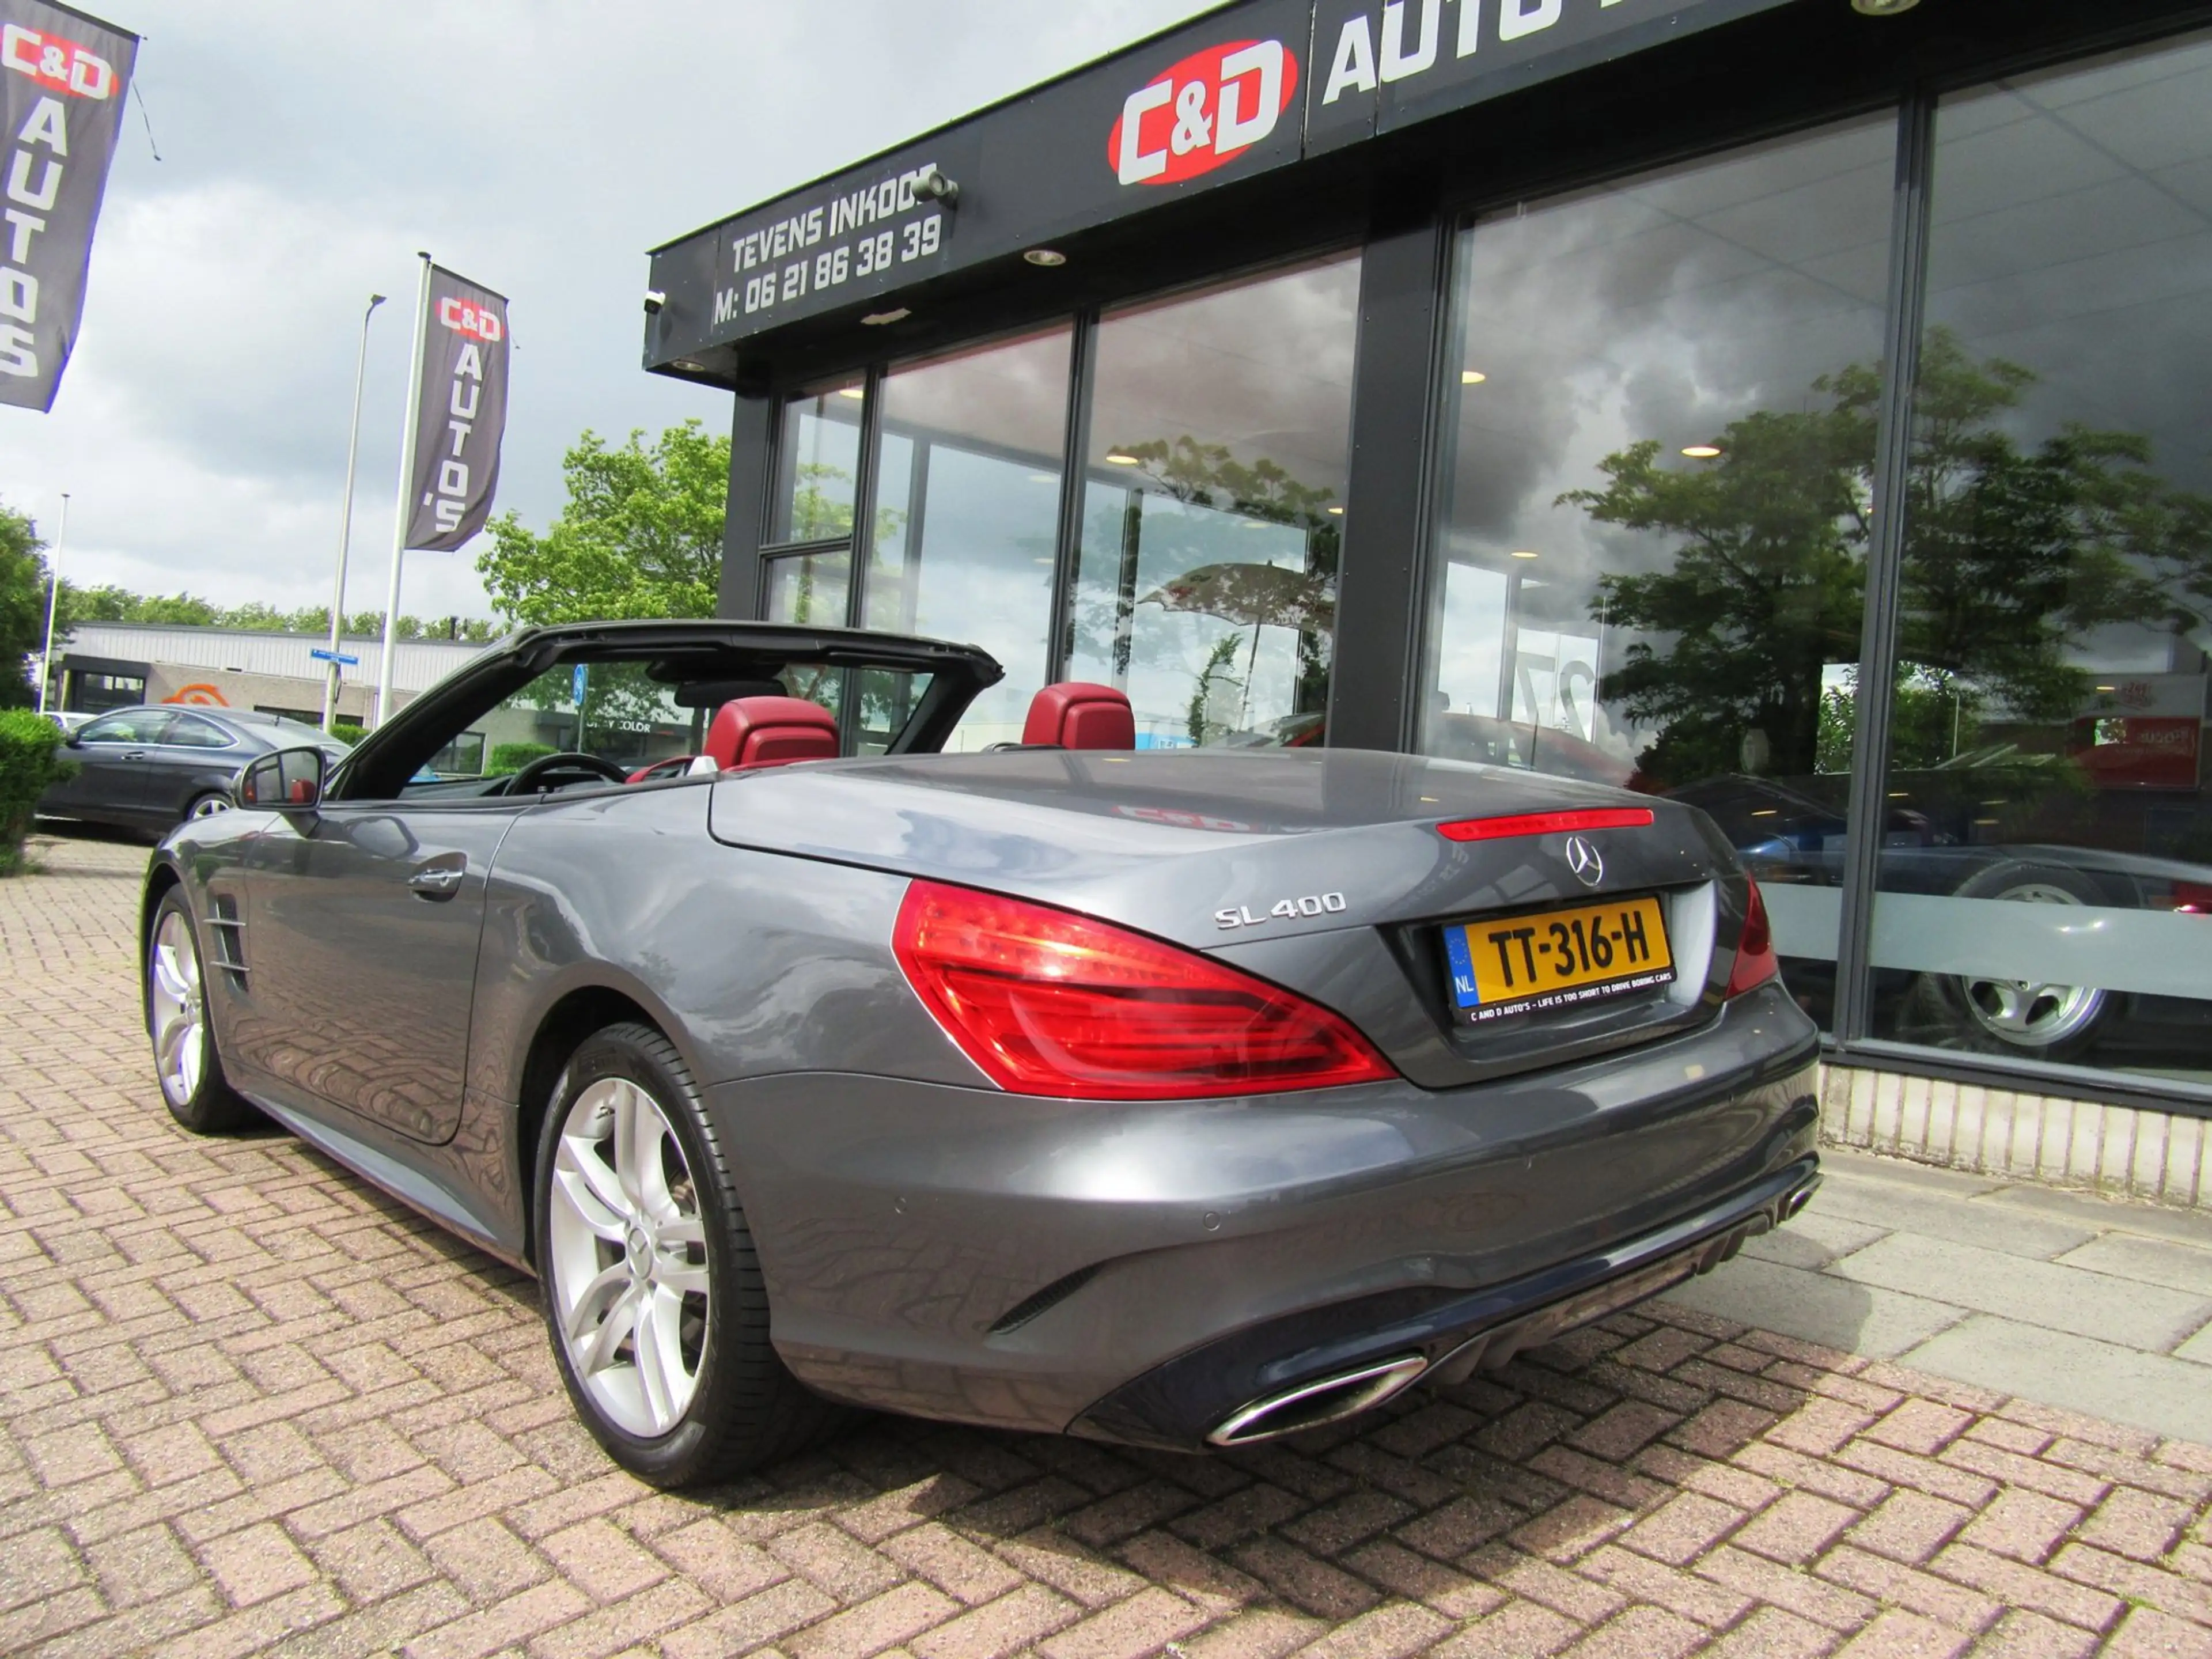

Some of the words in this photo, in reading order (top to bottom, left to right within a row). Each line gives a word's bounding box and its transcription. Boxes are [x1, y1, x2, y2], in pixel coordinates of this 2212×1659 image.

[2, 24, 112, 100] C&D
[1118, 40, 1283, 185] C&D
[714, 288, 739, 325] M:
[745, 271, 777, 314] 06
[782, 260, 808, 301] 21
[814, 246, 850, 291] 86
[856, 230, 894, 277] 38
[902, 214, 942, 263] 39
[733, 206, 824, 273] TEVENS
[441, 297, 501, 342] C&D
[1214, 906, 1267, 930] SL
[1270, 892, 1347, 919] 400
[1488, 910, 1650, 988] TT-316-H
[1455, 975, 1474, 994] NL
[1471, 1012, 1477, 1021] C
[1479, 1009, 1495, 1020] AND
[1496, 1007, 1502, 1016] D
[1504, 1002, 1531, 1014] AUTO'S
[1537, 998, 1554, 1007] LIFE
[1555, 995, 1562, 1003] IS
[1563, 993, 1577, 1002] TOO
[1578, 987, 1600, 999] SHORT
[1601, 985, 1610, 994] TO
[1611, 980, 1631, 991] DRIVE
[1631, 976, 1655, 988] BORING
[1656, 972, 1672, 983] CARS
